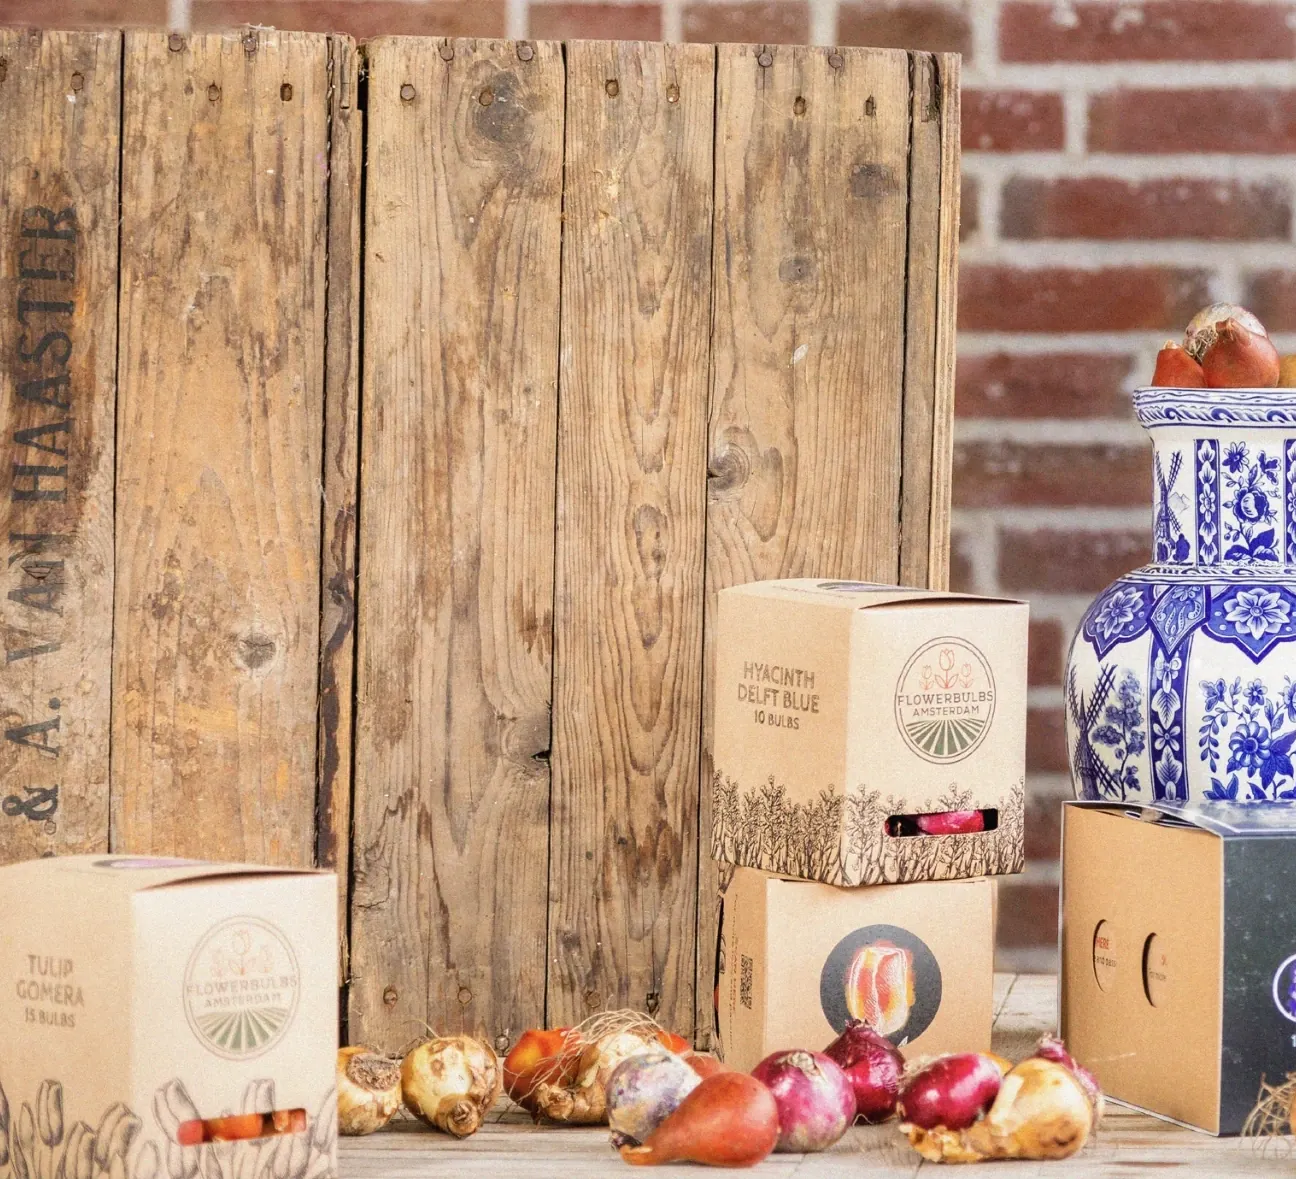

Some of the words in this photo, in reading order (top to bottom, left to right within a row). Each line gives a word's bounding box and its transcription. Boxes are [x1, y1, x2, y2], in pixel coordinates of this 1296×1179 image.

[11, 205, 76, 503] HAASTER
[6, 532, 65, 664] VAN
[744, 661, 815, 690] HYACINTH
[738, 683, 779, 707] DELFT
[783, 690, 820, 714] BLUE
[898, 690, 993, 706] FLOWERBULBS
[913, 705, 979, 717] AMSTERDAM
[4, 698, 61, 758] A.
[754, 709, 765, 724] 10
[768, 713, 800, 730] BULBS
[2, 784, 59, 823] &
[28, 954, 73, 978] TULIP
[16, 979, 85, 1008] GOMERA
[186, 976, 297, 997] FLOWERBULBS
[204, 992, 281, 1008] AMSTERDAM
[25, 1007, 36, 1023] 15
[39, 1009, 76, 1028] BULBS
